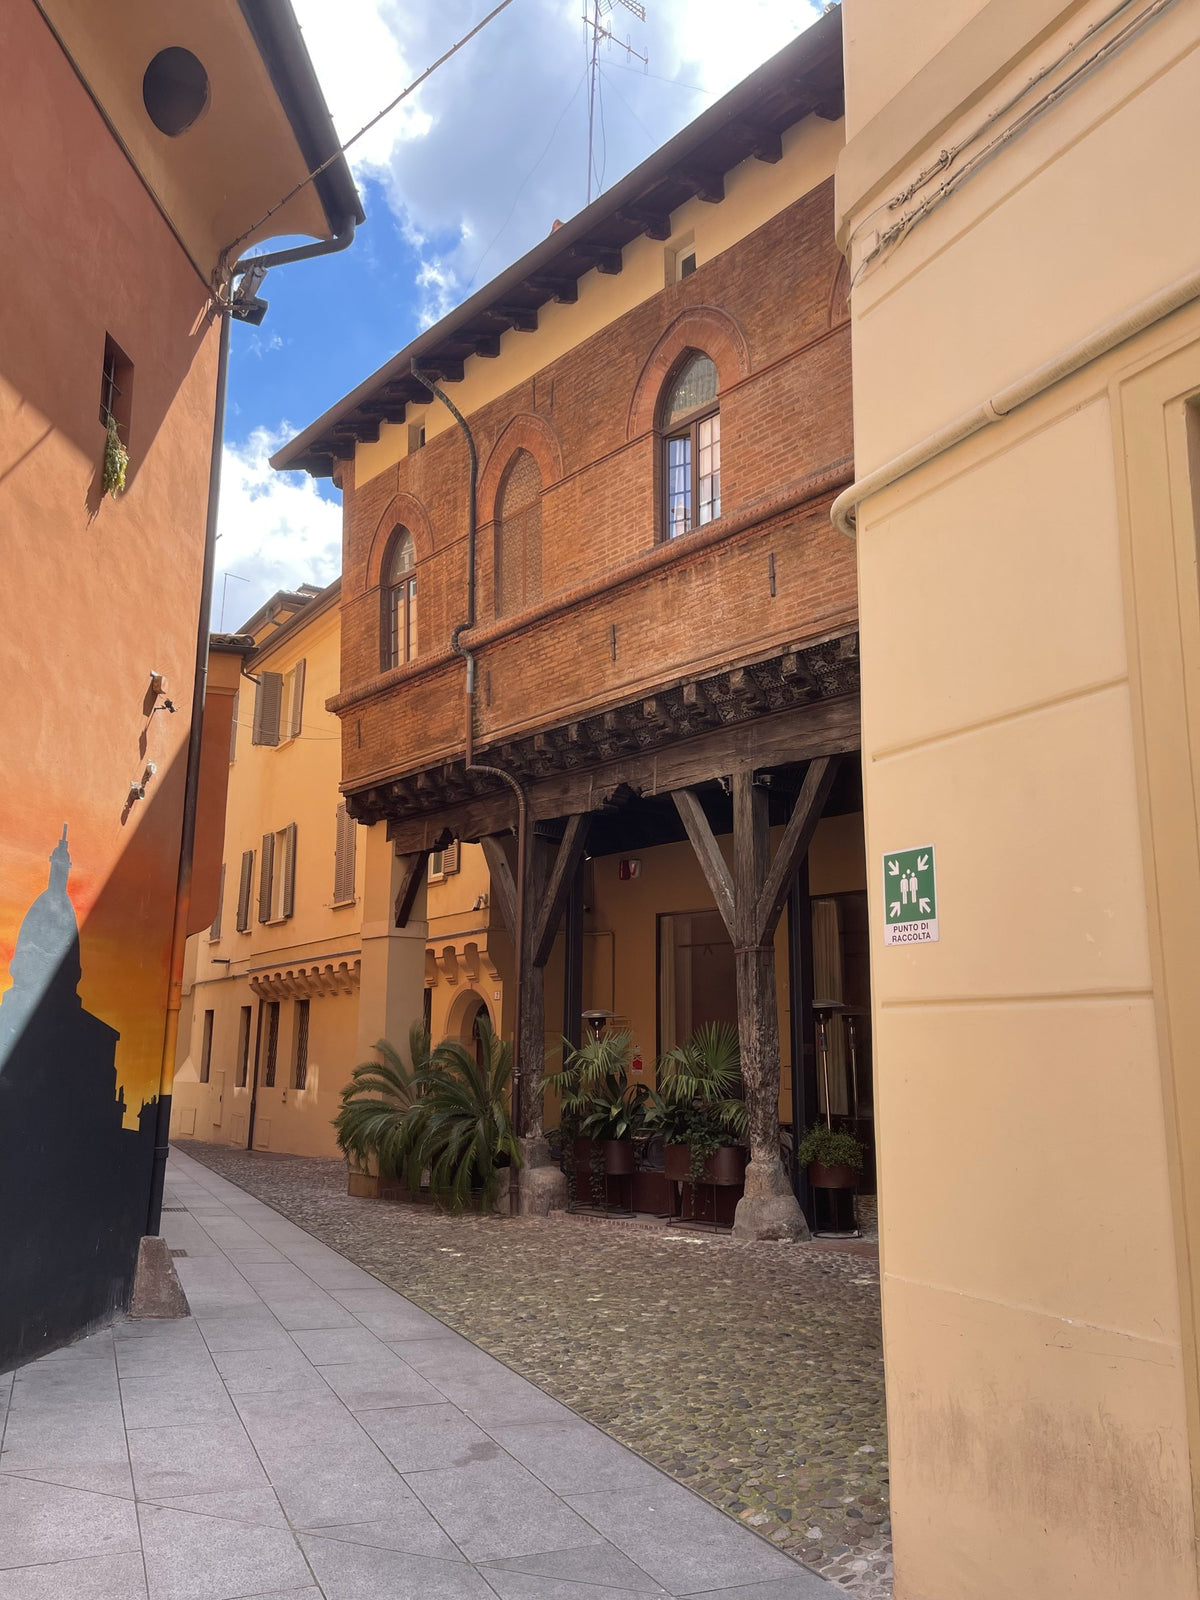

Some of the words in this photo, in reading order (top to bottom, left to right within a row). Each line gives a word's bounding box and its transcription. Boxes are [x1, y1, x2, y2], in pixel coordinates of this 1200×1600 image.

[893, 923, 919, 933] PUNTO
[920, 922, 929, 930] DI
[892, 931, 931, 943] RACCOLTA
